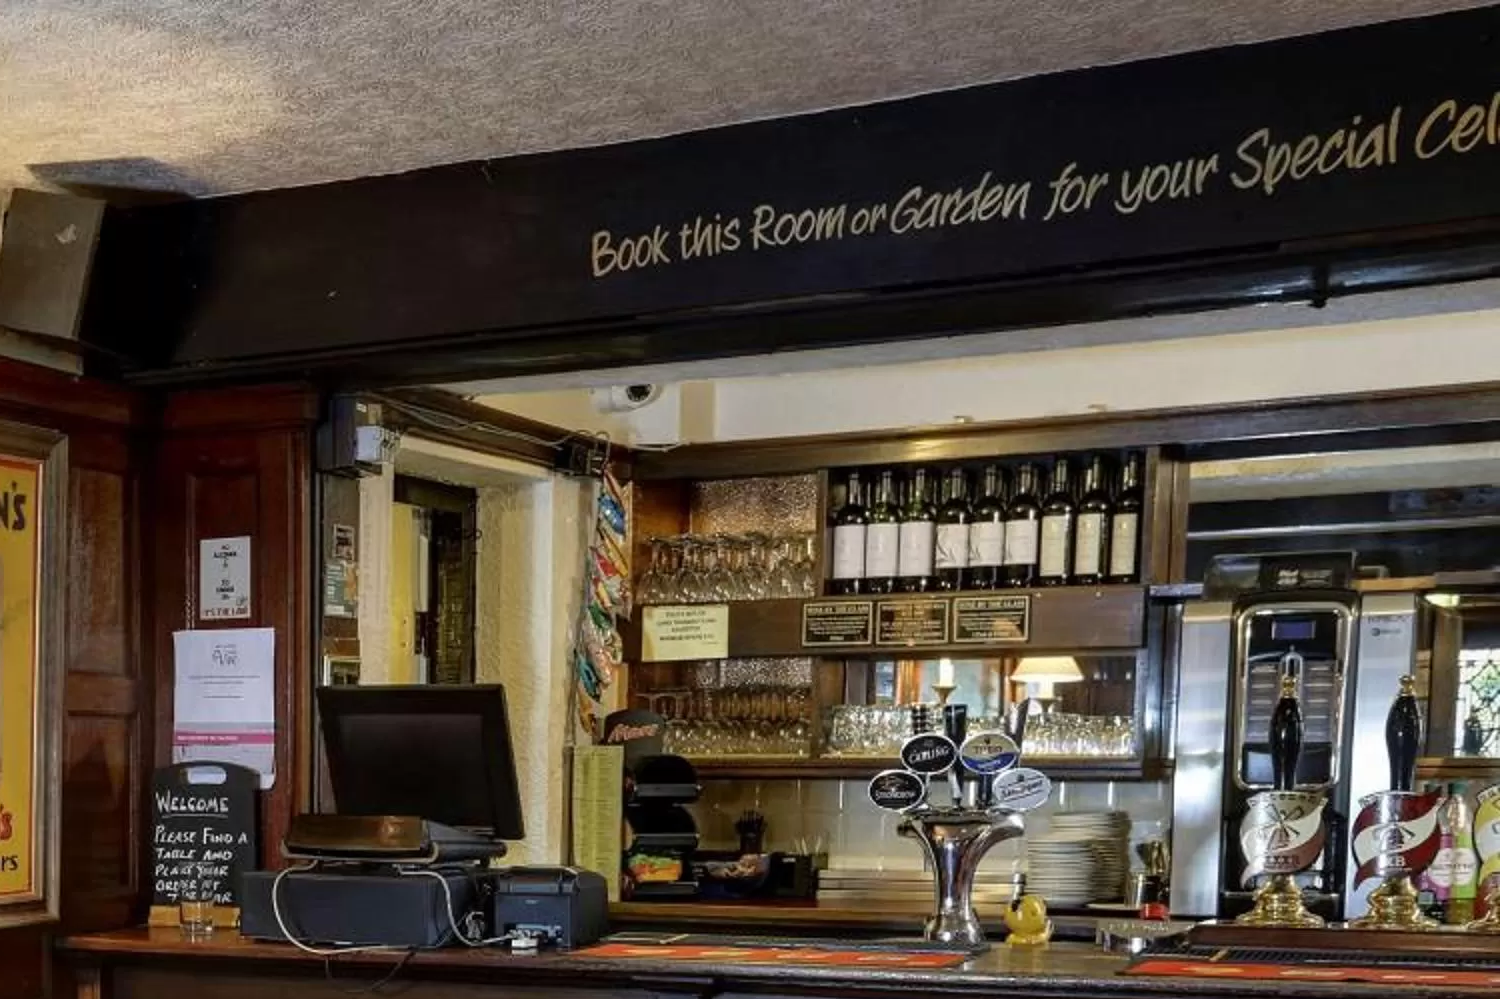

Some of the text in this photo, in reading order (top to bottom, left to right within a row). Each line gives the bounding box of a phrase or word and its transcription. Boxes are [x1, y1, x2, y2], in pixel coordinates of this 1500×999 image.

[592, 224, 670, 277] Book
[679, 212, 742, 260] this
[750, 204, 847, 250] Room
[851, 202, 888, 234] or
[890, 171, 1031, 235] Garden
[1043, 161, 1108, 222] for
[1114, 153, 1219, 214] your
[1230, 106, 1402, 196] Special
[155, 789, 229, 814] WELCOME
[155, 825, 248, 844] PLEASE FIND A
[155, 847, 233, 861] TABLE AND
